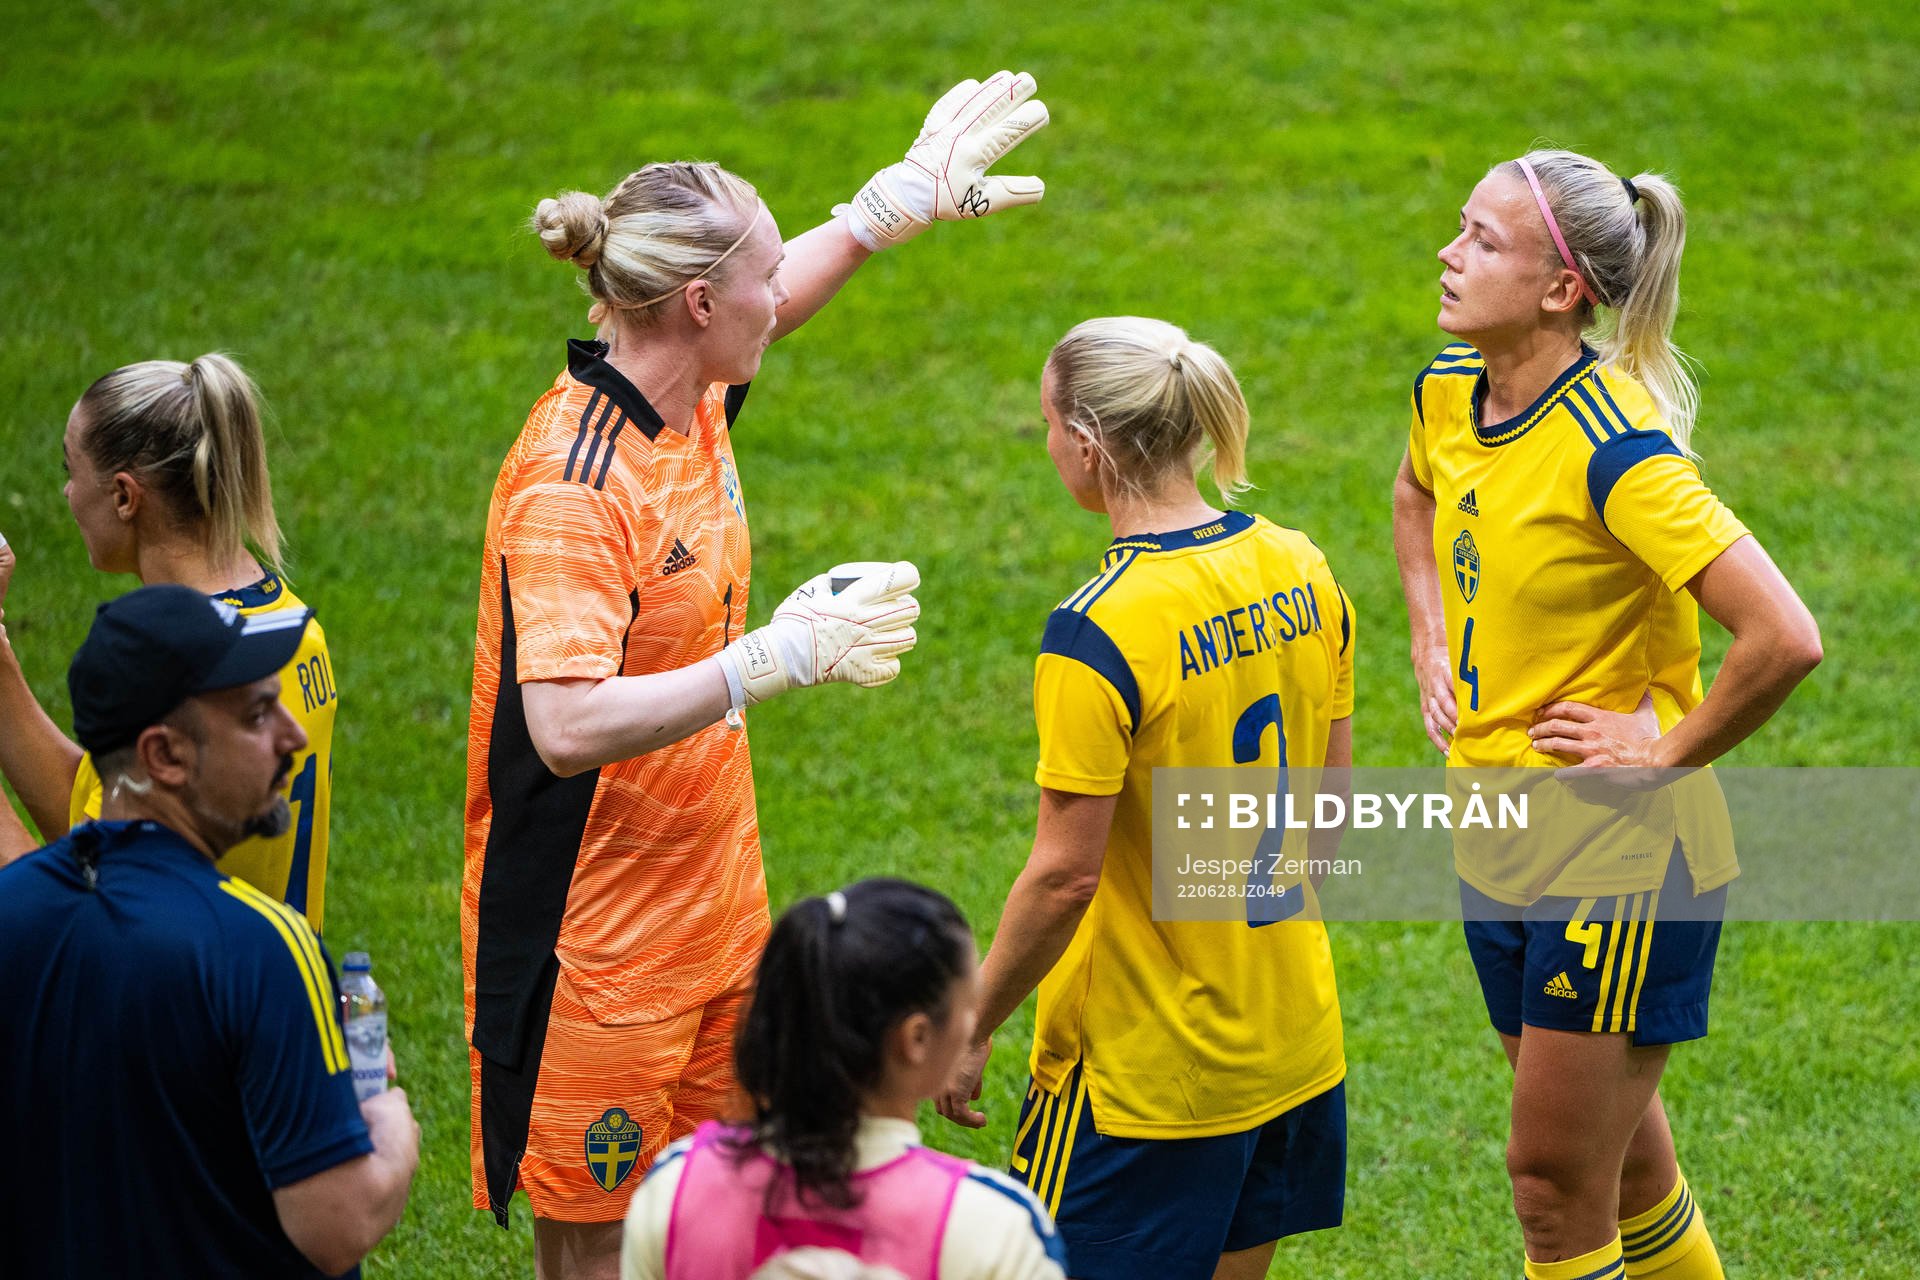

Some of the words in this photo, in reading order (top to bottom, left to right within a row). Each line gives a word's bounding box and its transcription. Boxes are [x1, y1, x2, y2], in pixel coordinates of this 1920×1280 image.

[868, 186, 901, 223] HEDVIG
[1457, 502, 1480, 518] adidas
[1193, 523, 1226, 540] SVERIGE
[662, 554, 696, 576] adidas
[1459, 616, 1479, 712] 4
[1232, 693, 1305, 928] 2
[1565, 897, 1603, 969] 4
[1544, 985, 1578, 999] adidas
[594, 1133, 634, 1142] SVERIGE
